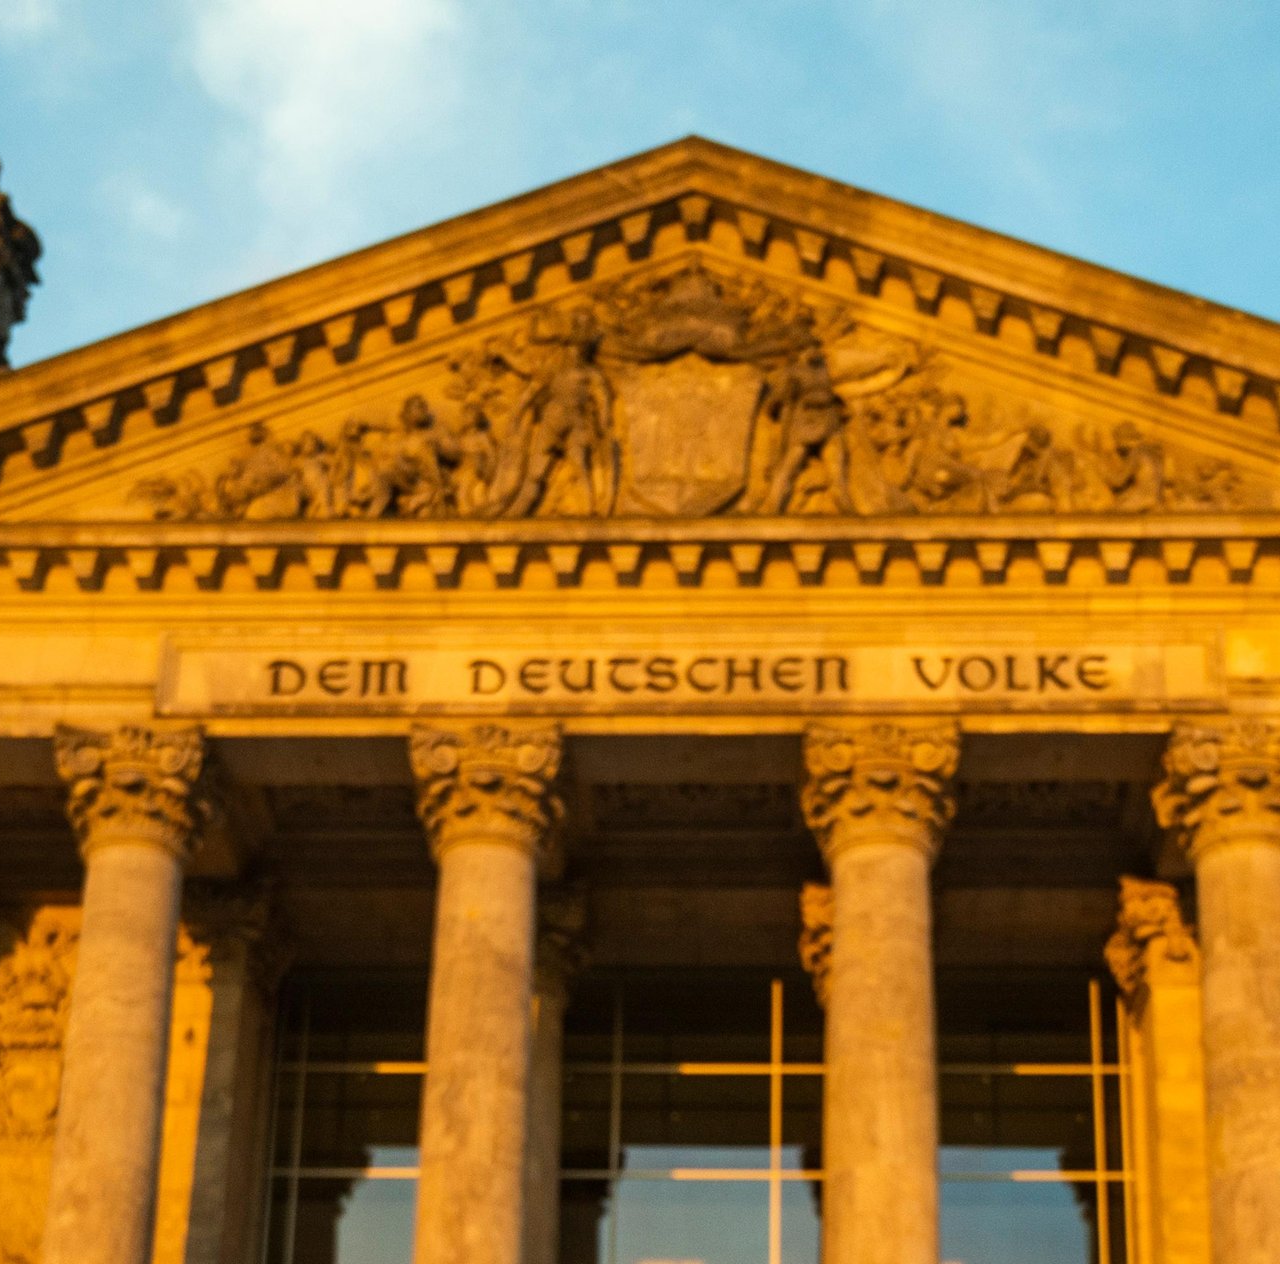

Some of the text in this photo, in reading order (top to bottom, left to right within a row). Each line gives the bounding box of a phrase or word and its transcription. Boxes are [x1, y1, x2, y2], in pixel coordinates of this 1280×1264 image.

[268, 654, 1110, 696] DEM DEUTSCHEN VOLKE
